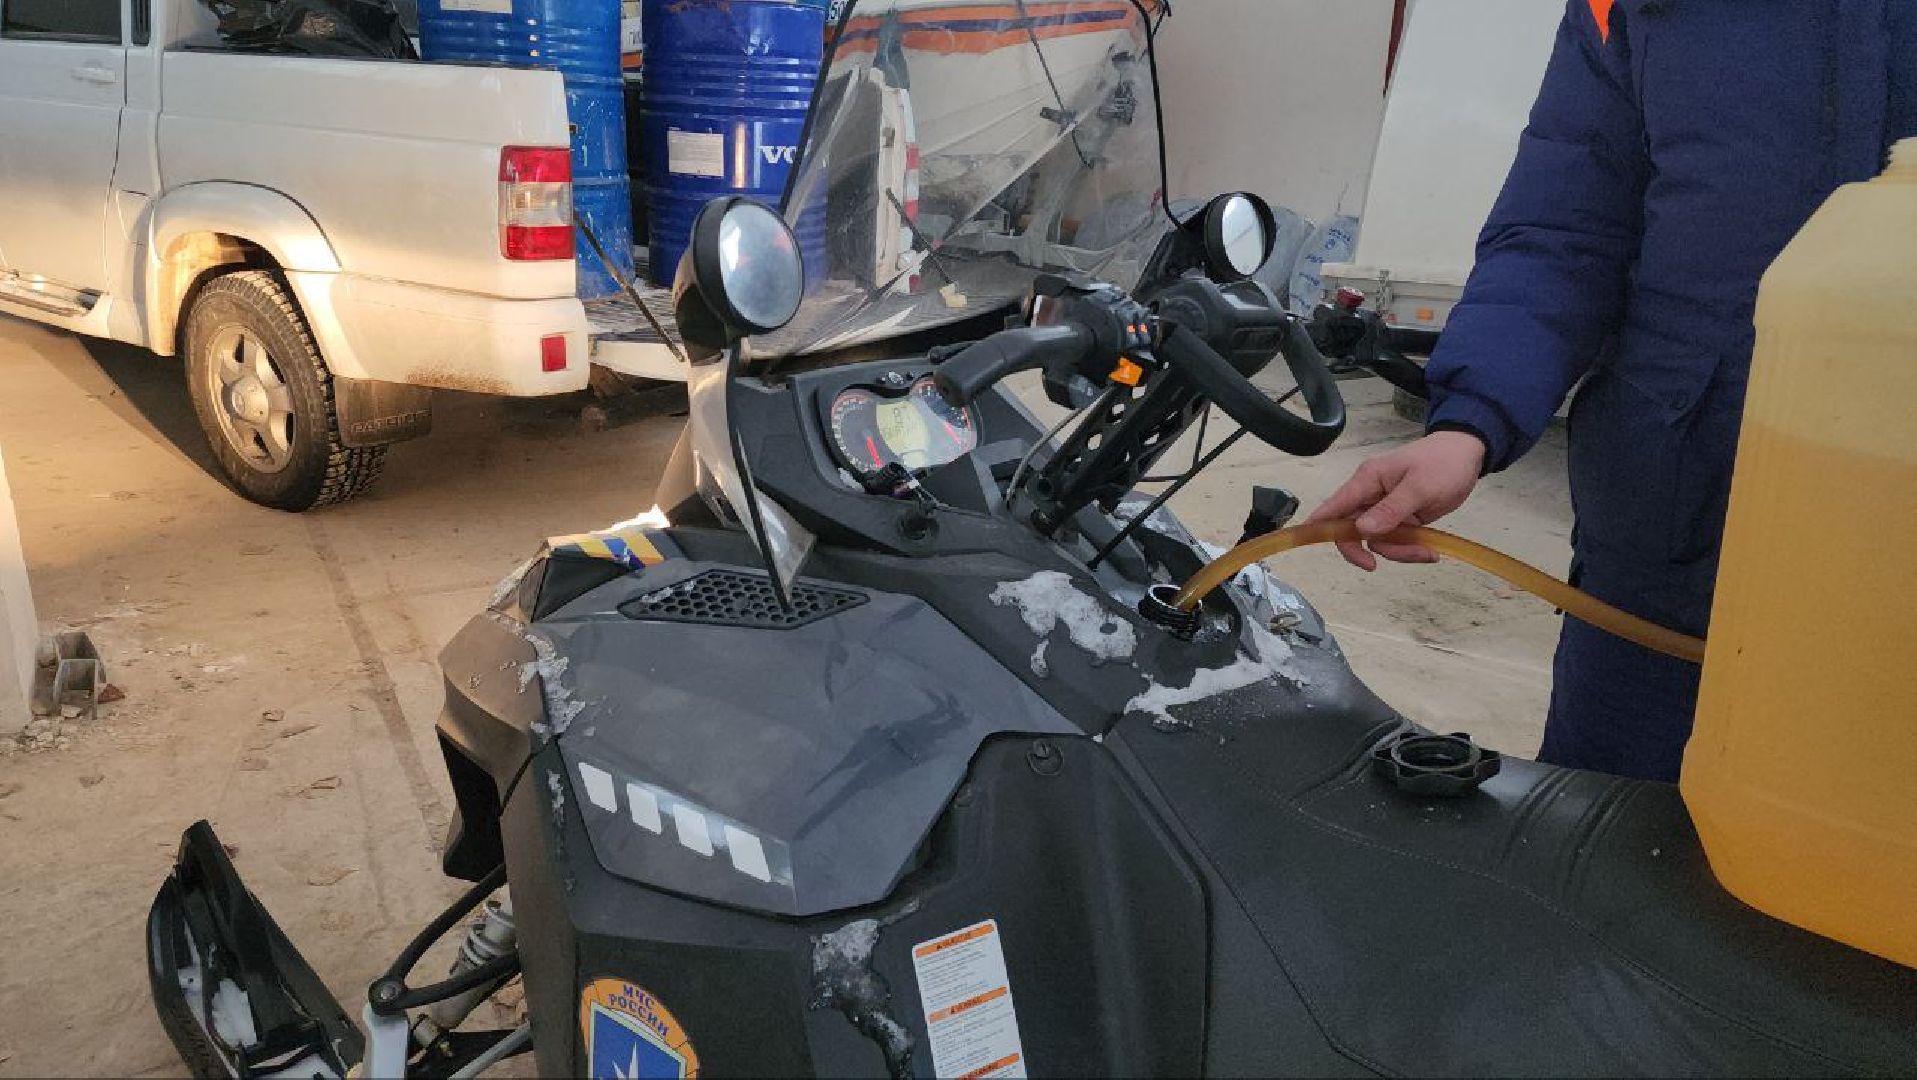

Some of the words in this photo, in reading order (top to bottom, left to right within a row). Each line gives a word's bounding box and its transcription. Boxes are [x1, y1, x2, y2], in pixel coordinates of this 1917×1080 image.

[759, 145, 797, 164] VO
[623, 983, 655, 1010] МЧС
[607, 993, 670, 1036] РОССИИ
